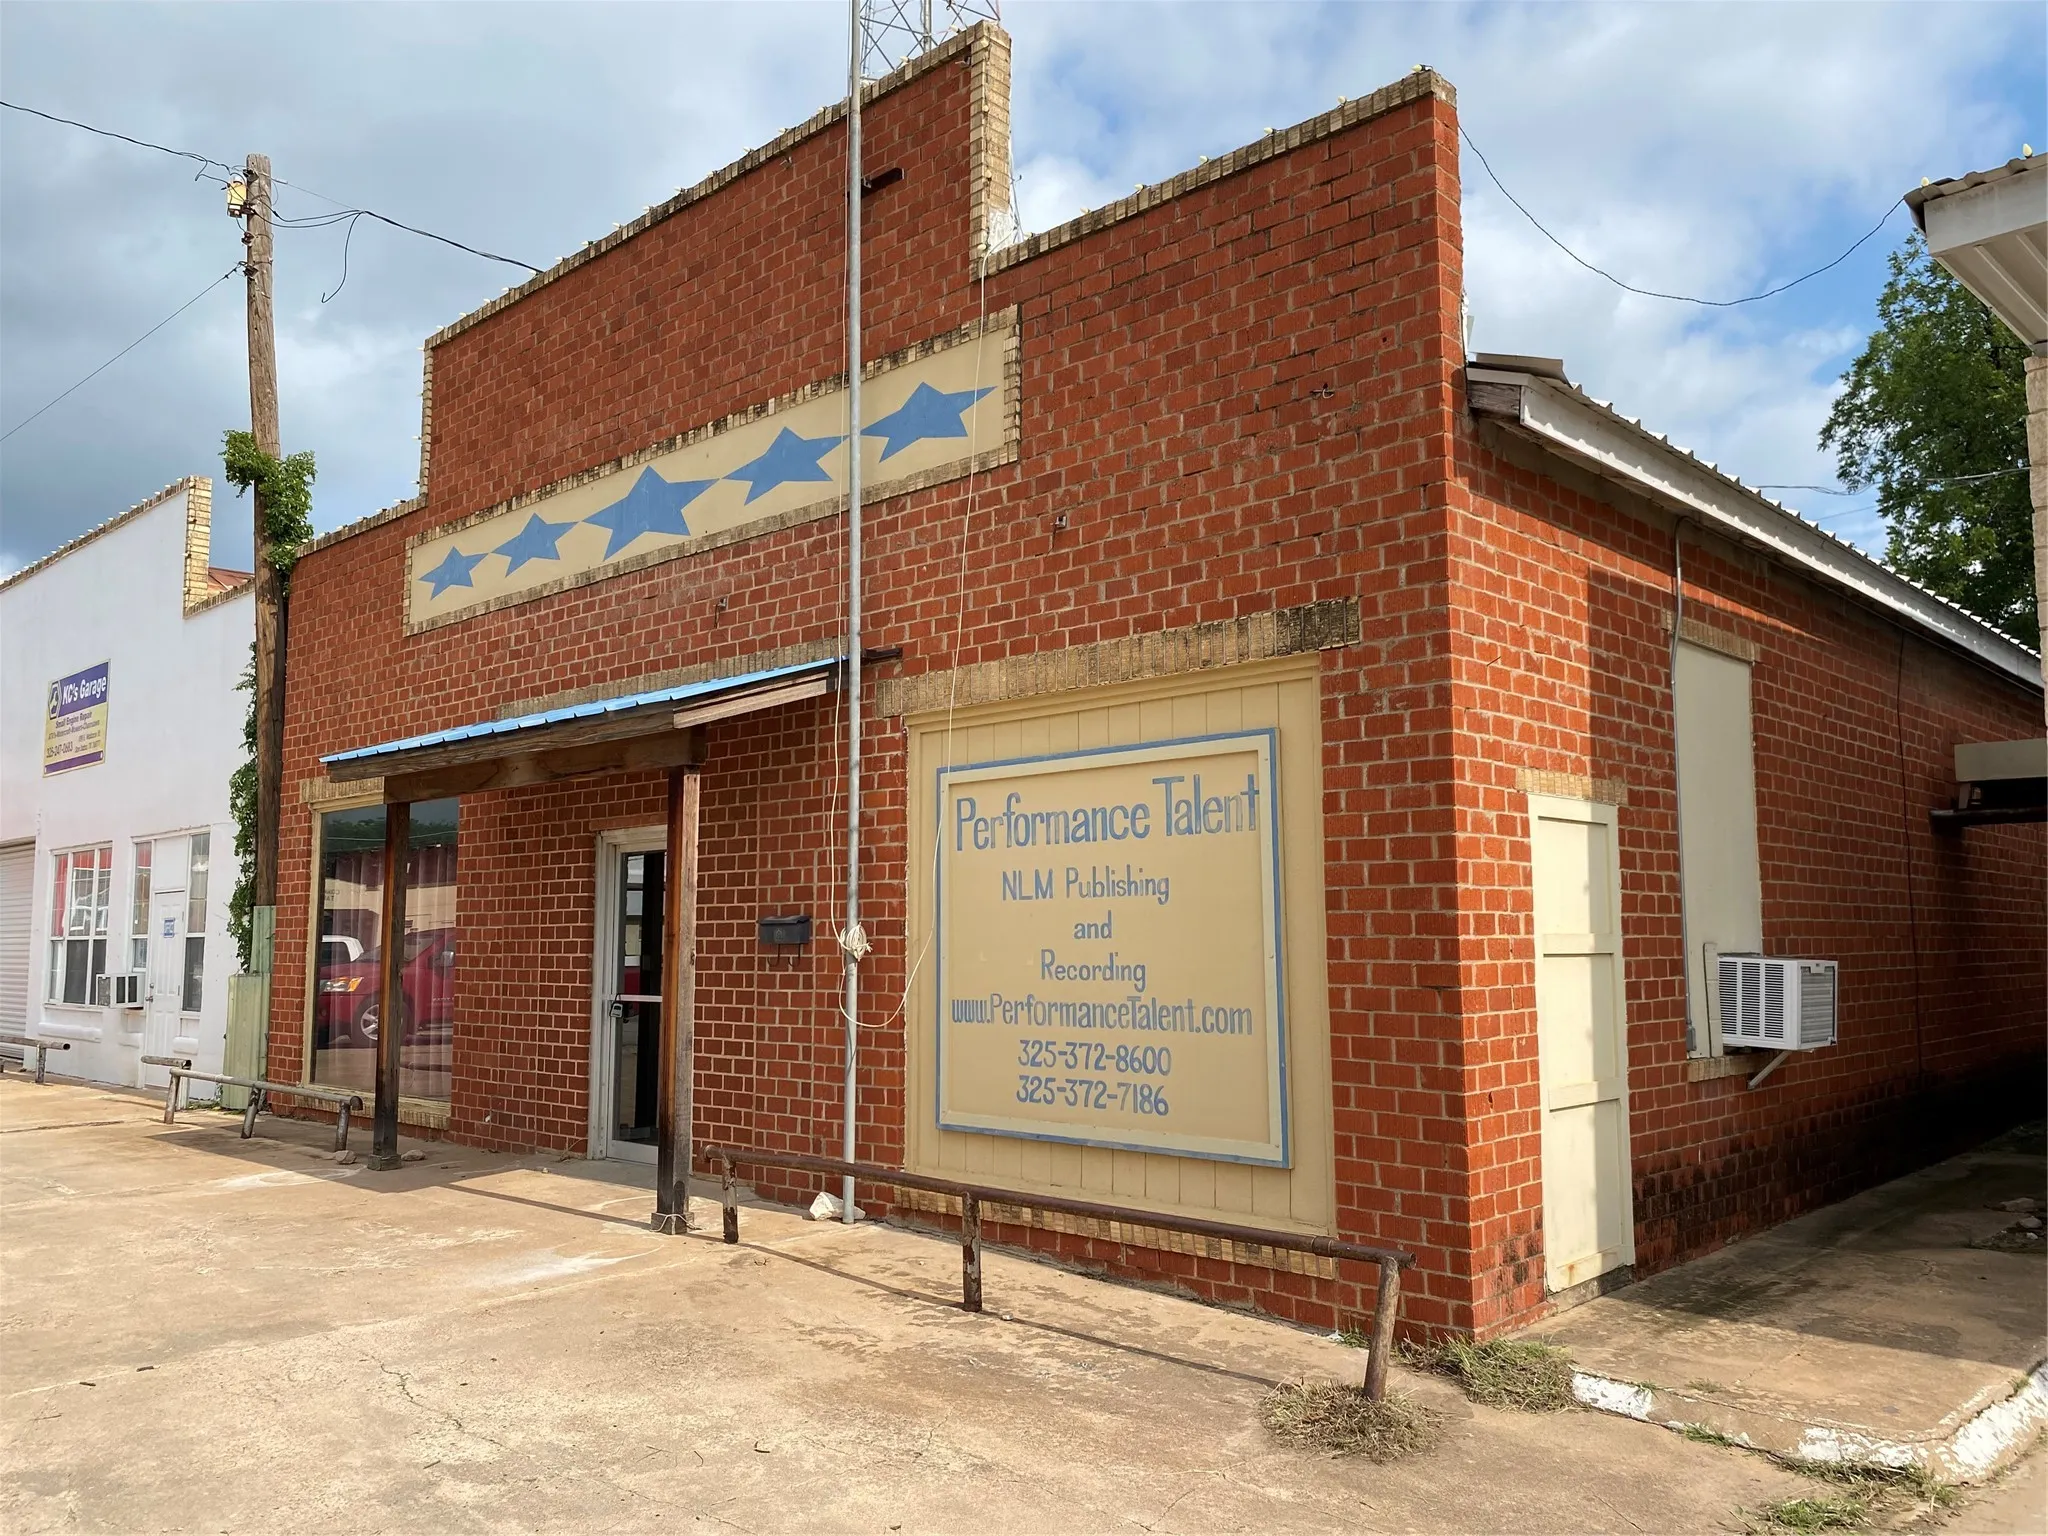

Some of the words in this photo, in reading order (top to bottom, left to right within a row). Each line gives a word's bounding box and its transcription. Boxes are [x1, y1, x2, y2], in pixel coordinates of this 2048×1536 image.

[62, 682, 78, 705] KC's
[80, 676, 106, 699] Garage
[956, 792, 1151, 852] Performance
[1152, 773, 1261, 836] Talent
[1002, 869, 1054, 900] NLM
[1066, 864, 1170, 905] Publishing
[1073, 910, 1113, 939] and
[1041, 949, 1147, 992] Recording
[951, 993, 1253, 1035] www.PerformanceTalent.com
[1018, 1040, 1172, 1077] 325-372-8600
[1016, 1076, 1169, 1116] 325-372-7186
